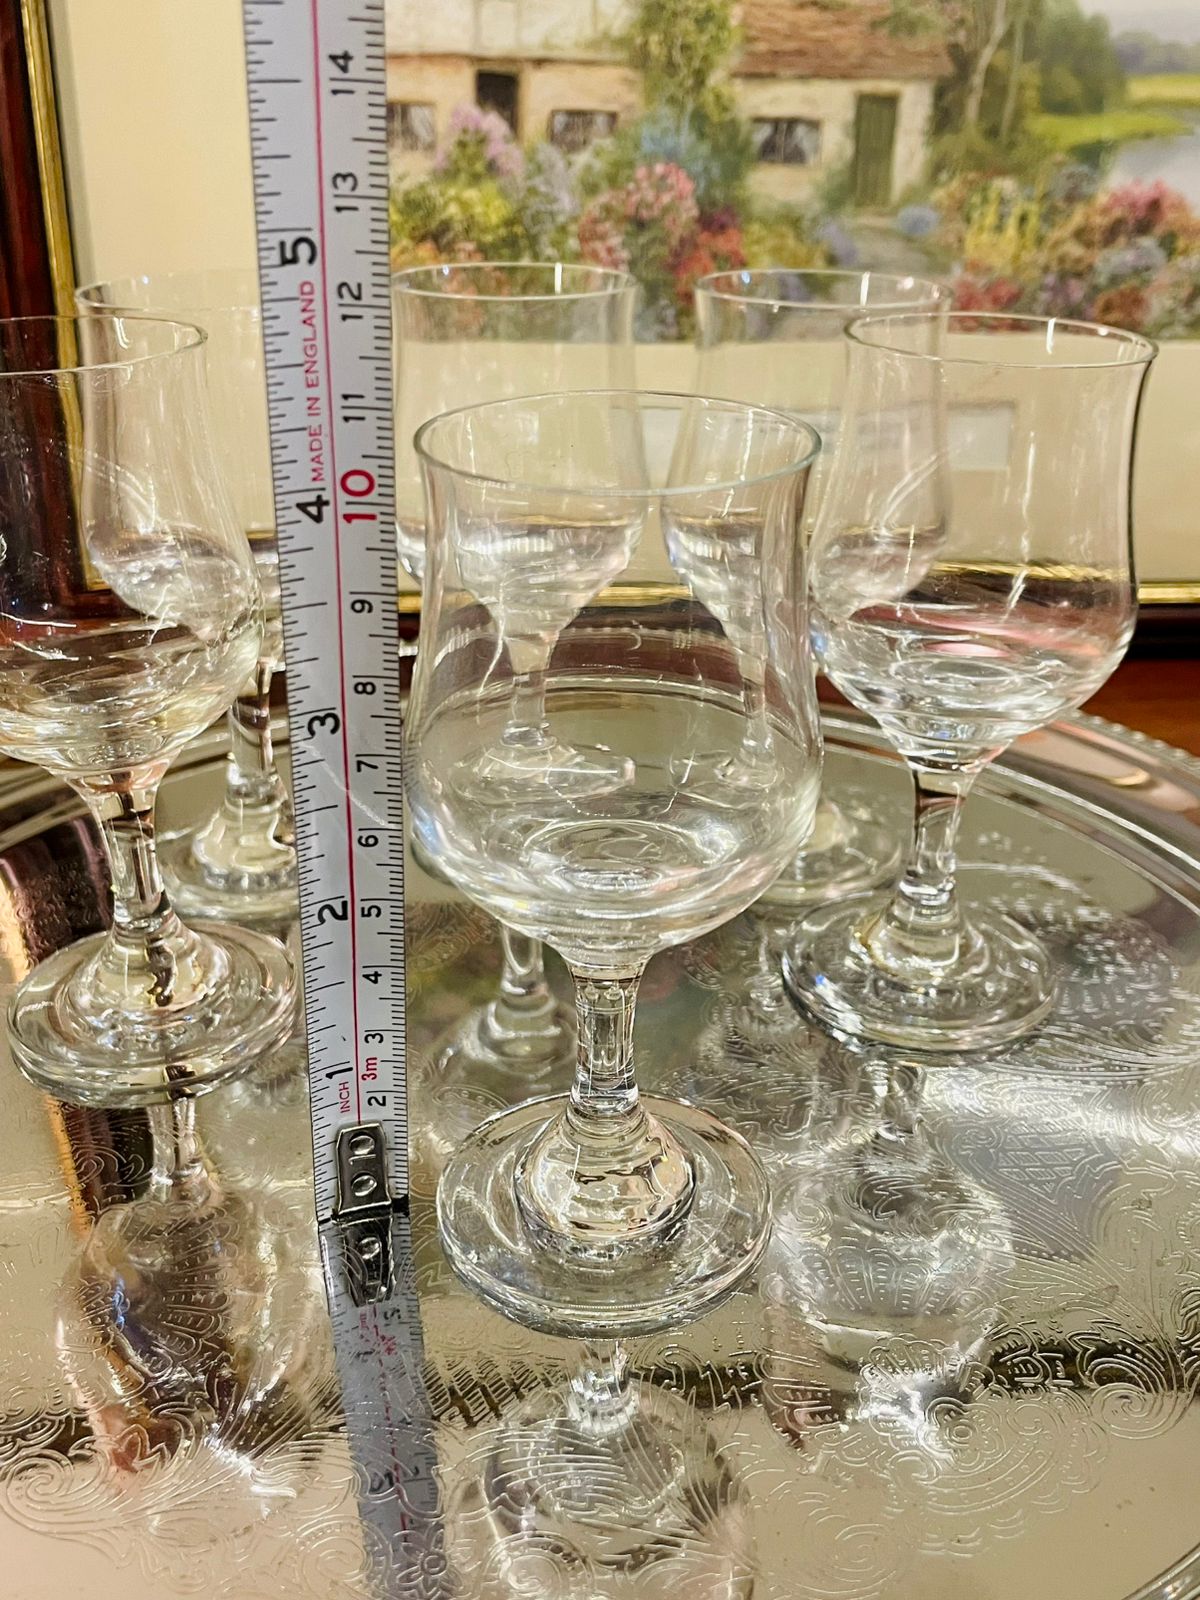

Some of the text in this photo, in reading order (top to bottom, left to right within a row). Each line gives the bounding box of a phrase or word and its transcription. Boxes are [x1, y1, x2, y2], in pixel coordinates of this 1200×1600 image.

[279, 236, 317, 266] 5
[337, 281, 364, 322] 12
[298, 280, 325, 483] MADE IN ENGLAND
[340, 469, 377, 524] 10
[296, 494, 330, 524] 4
[350, 599, 374, 614] 9
[353, 681, 376, 695] 8
[307, 712, 341, 735] 3
[356, 760, 379, 773] 7
[357, 834, 379, 848] 6
[317, 900, 348, 925] 2
[360, 904, 382, 918] 5
[362, 970, 382, 985] 4
[364, 1032, 384, 1044] 3
[325, 1066, 354, 1080] 1
[361, 1056, 378, 1081] 3m
[338, 1081, 351, 1114] INCH
[367, 1095, 387, 1107] 2
